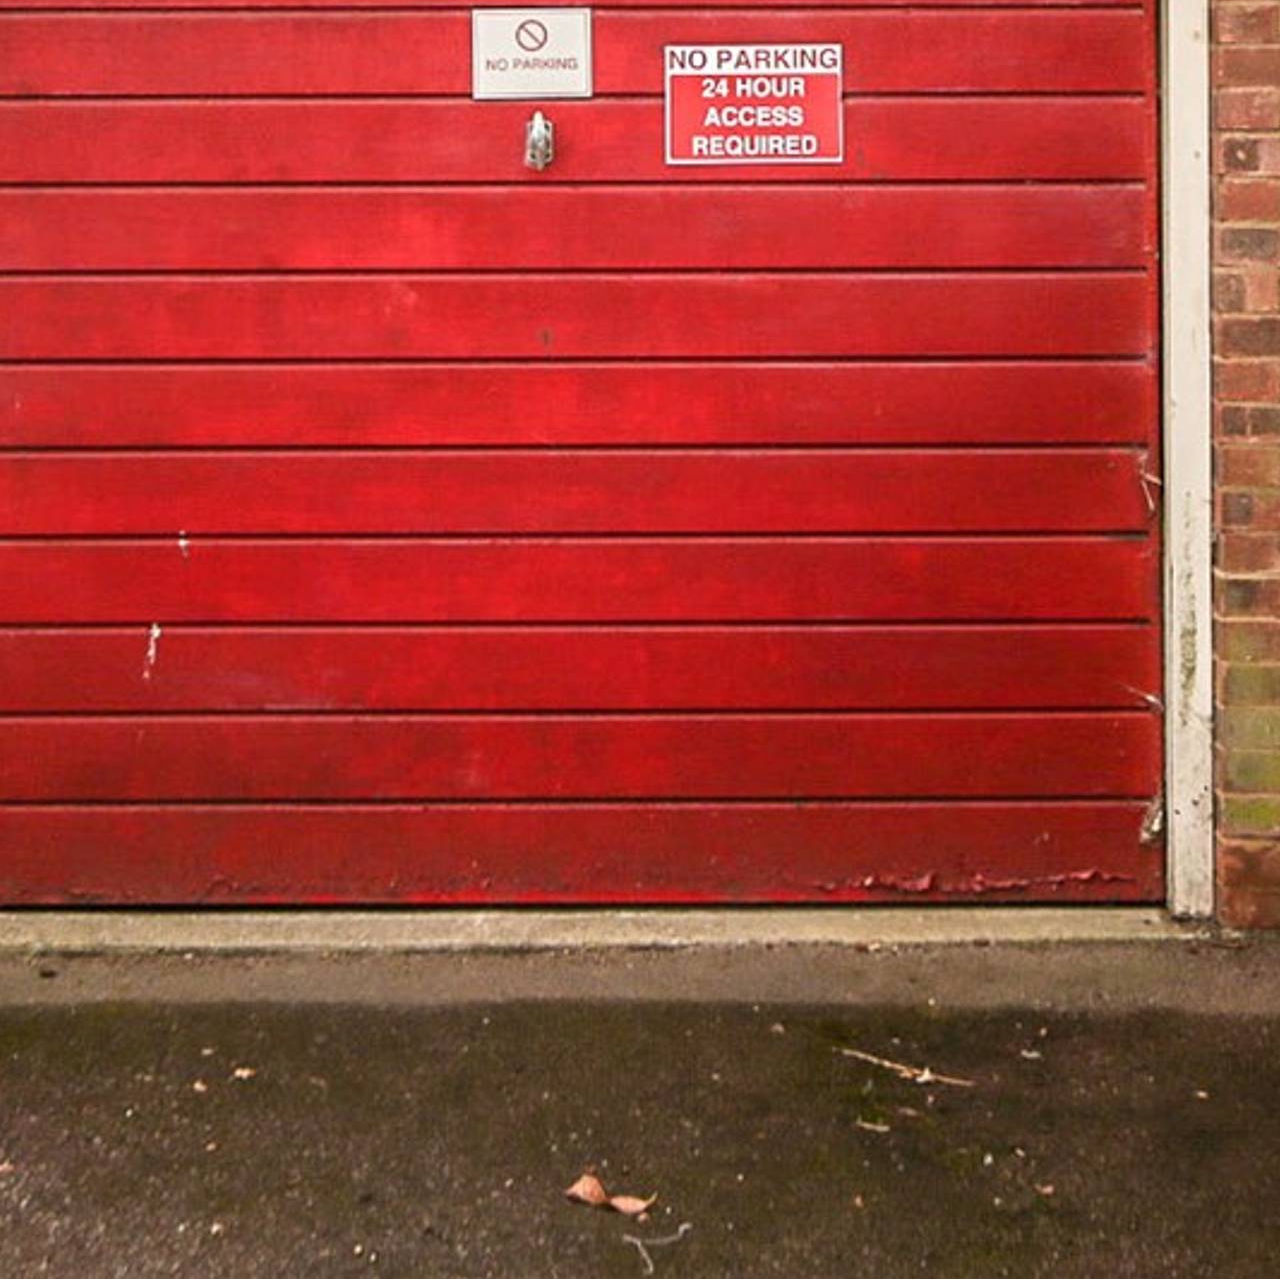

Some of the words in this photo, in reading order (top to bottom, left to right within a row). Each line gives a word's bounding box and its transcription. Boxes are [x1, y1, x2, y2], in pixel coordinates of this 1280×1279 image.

[485, 58, 508, 72] NO
[512, 57, 579, 71] PARKING
[669, 49, 708, 71] NO
[716, 48, 838, 69] PARKING
[701, 77, 729, 97] 24
[735, 76, 806, 97] HOUR
[703, 106, 804, 127] ACCESS
[692, 135, 818, 157] REQUIRED
